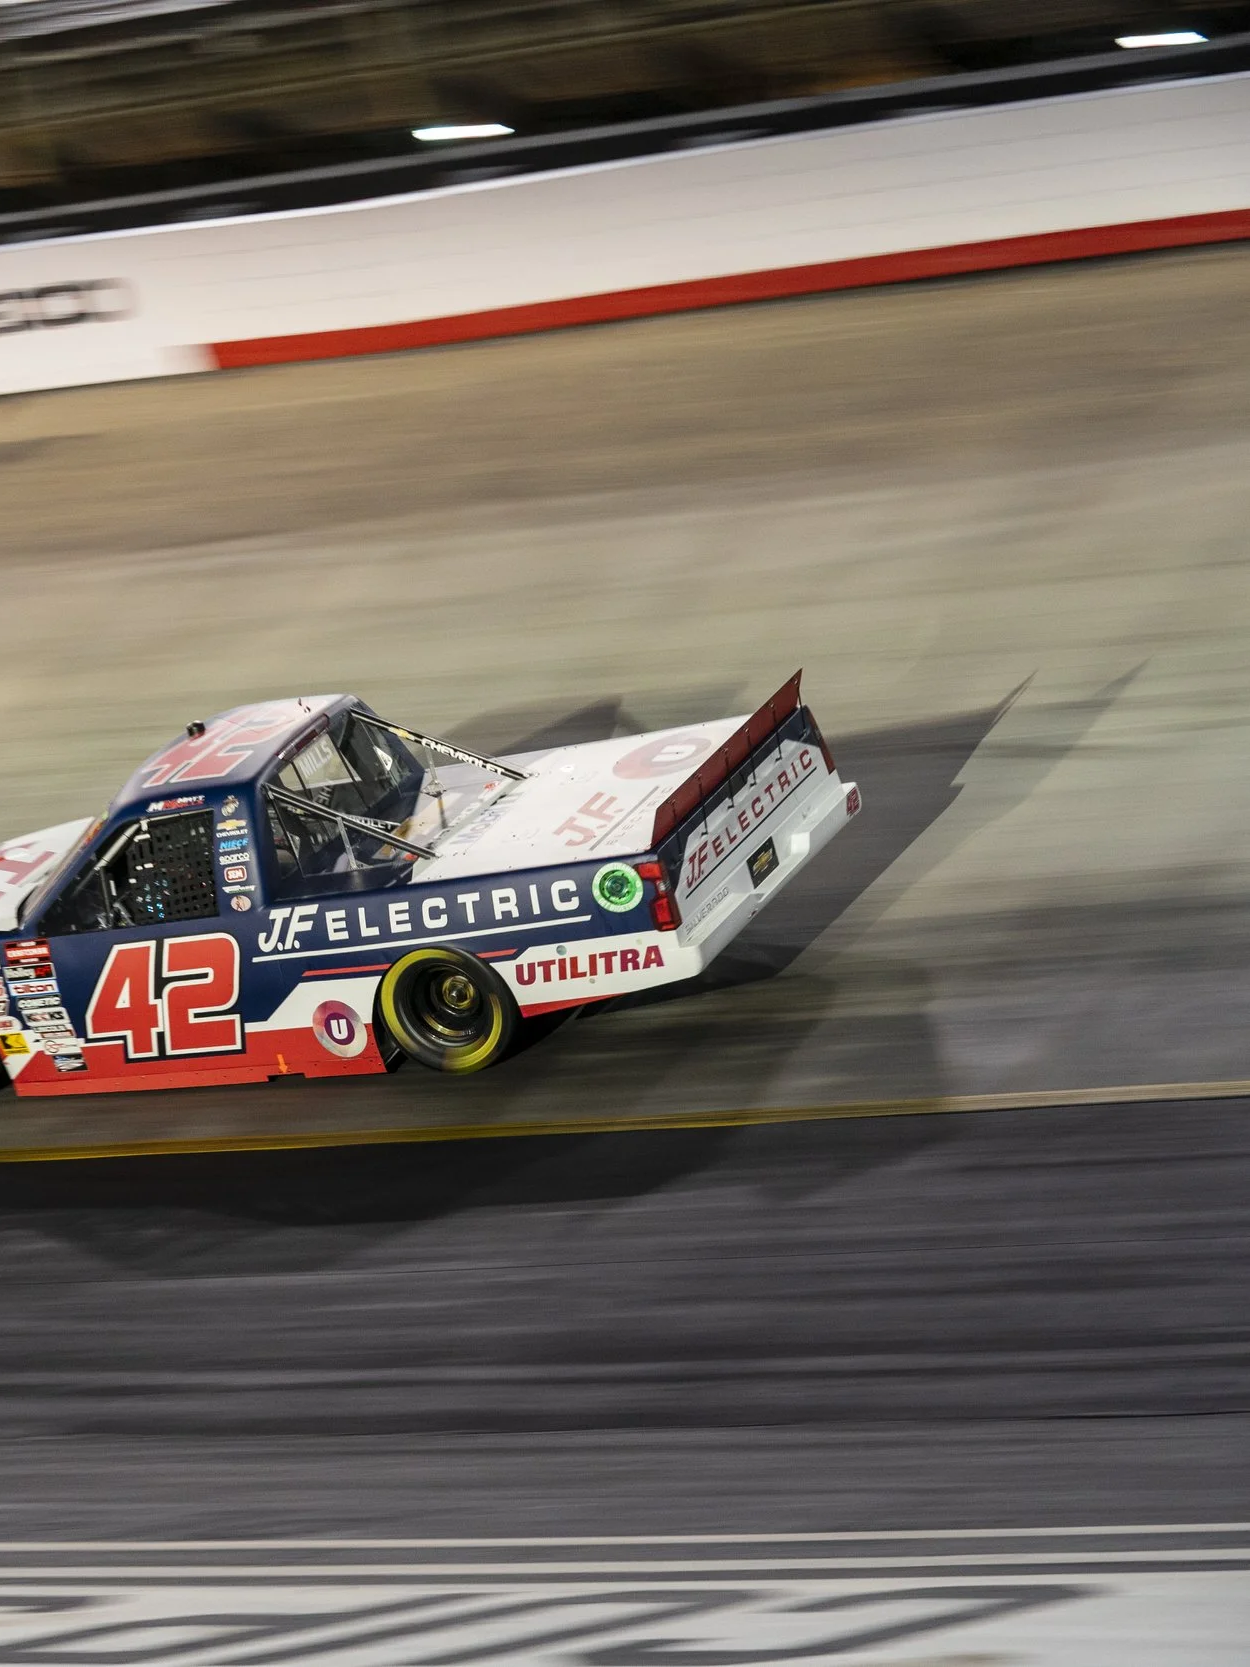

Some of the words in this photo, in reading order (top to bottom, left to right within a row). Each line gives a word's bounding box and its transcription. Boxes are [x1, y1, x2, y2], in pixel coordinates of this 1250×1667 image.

[299, 740, 333, 778] MILLS
[421, 738, 505, 775] CHEVROLET
[711, 749, 813, 858] ELECTRIC
[325, 879, 580, 942] ELECTRIC
[684, 886, 730, 936] SILVERADO
[515, 945, 665, 986] UTILITRA
[14, 983, 56, 995] tilton
[85, 932, 243, 1060] 42
[330, 1018, 350, 1040] U
